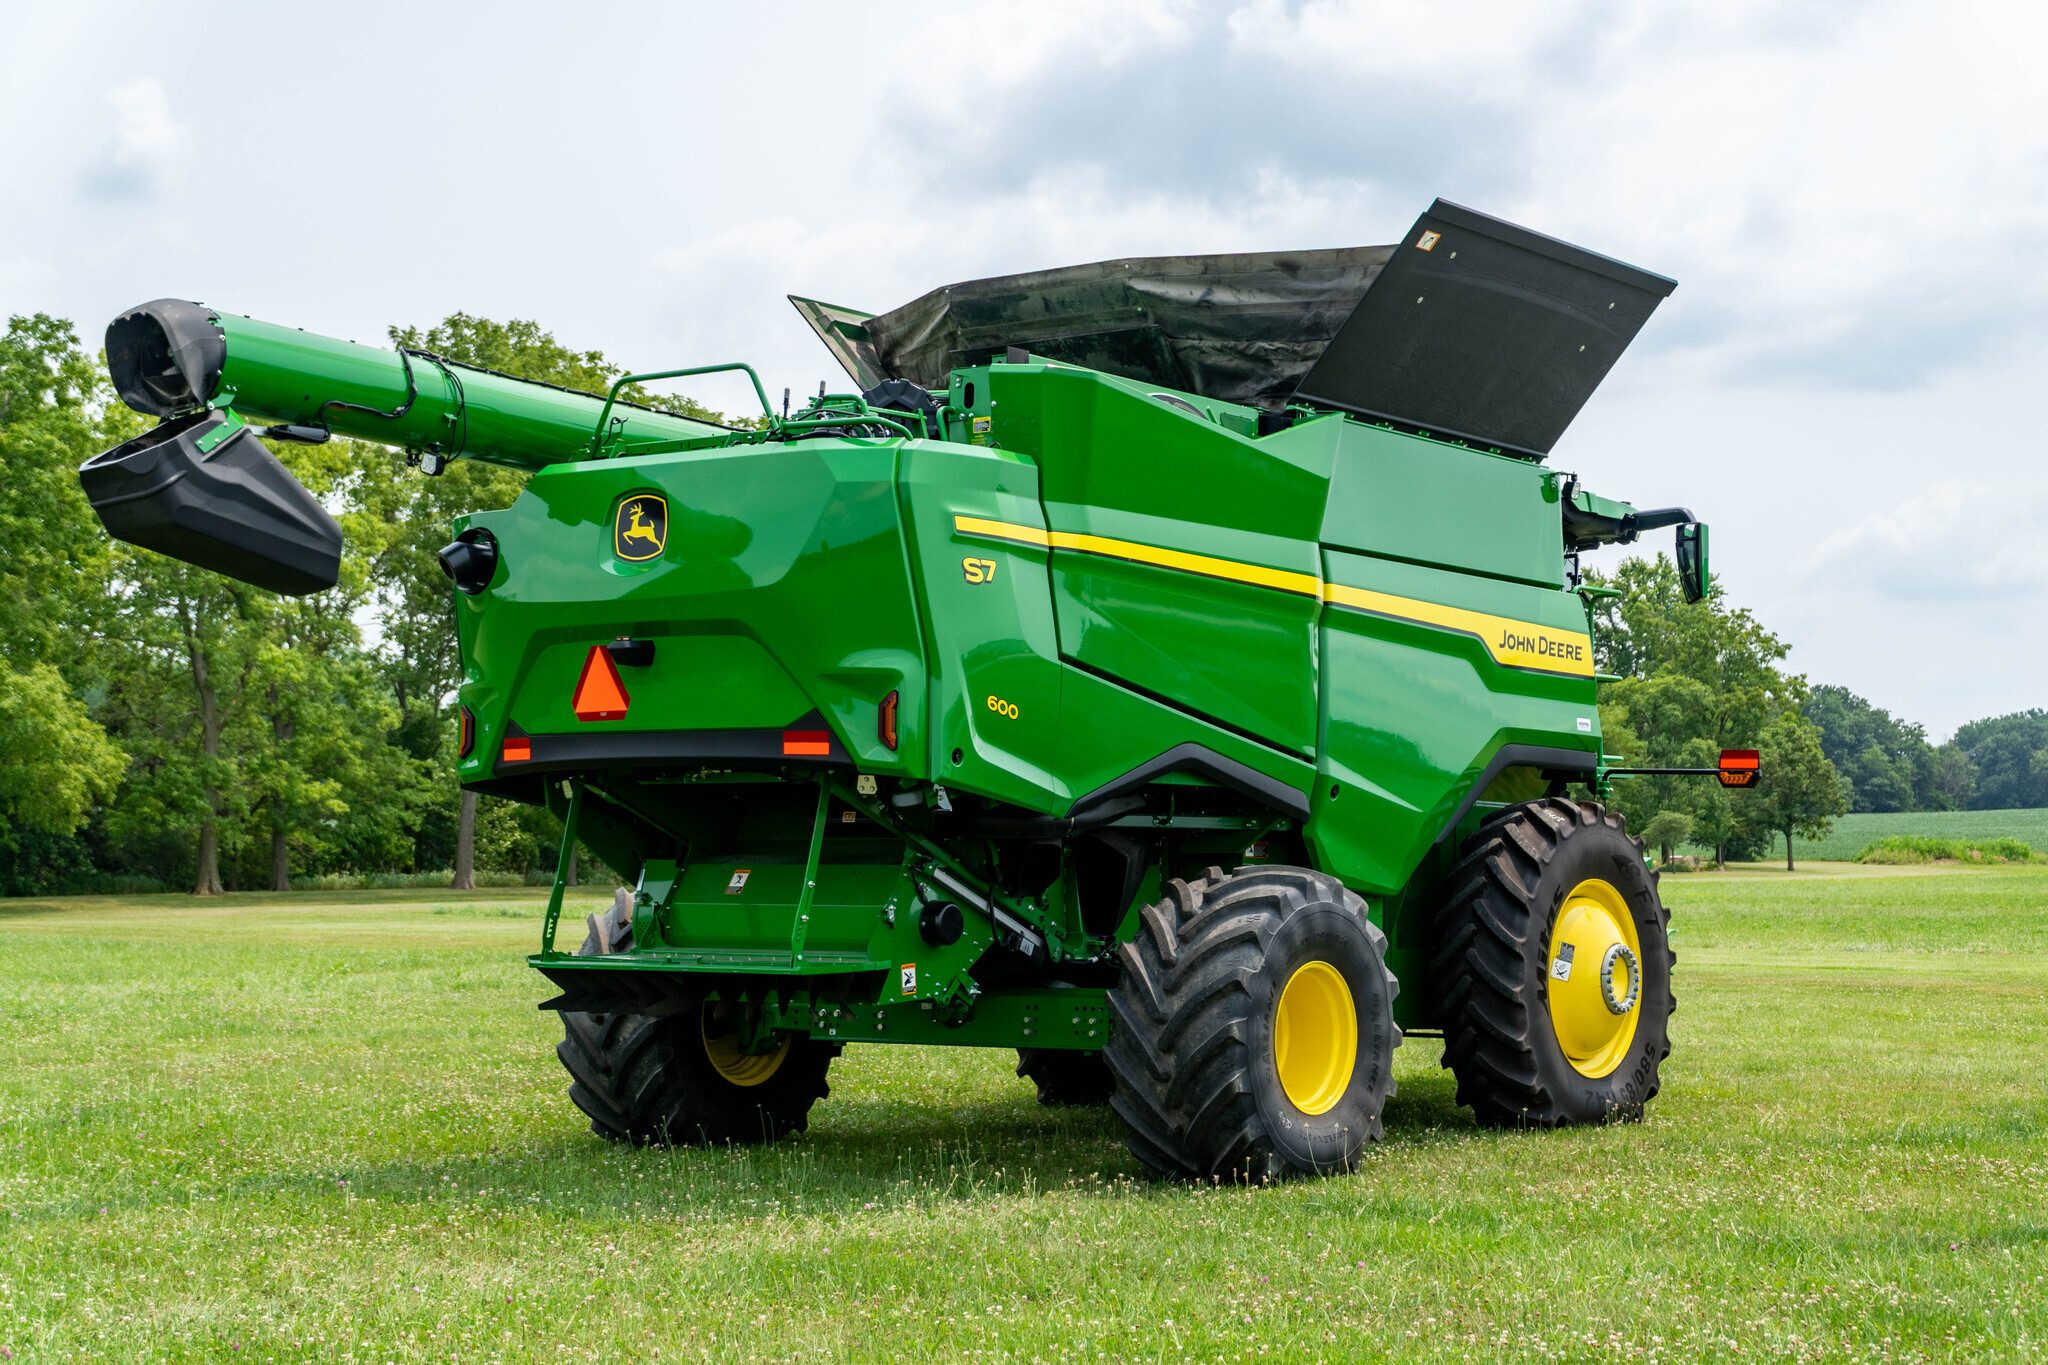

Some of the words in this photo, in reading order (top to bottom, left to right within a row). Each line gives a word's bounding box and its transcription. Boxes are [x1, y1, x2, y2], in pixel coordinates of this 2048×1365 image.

[962, 557, 997, 585] S7
[1499, 629, 1535, 653] JOHN
[1538, 635, 1583, 661] DEERE
[987, 695, 1019, 720] 600
